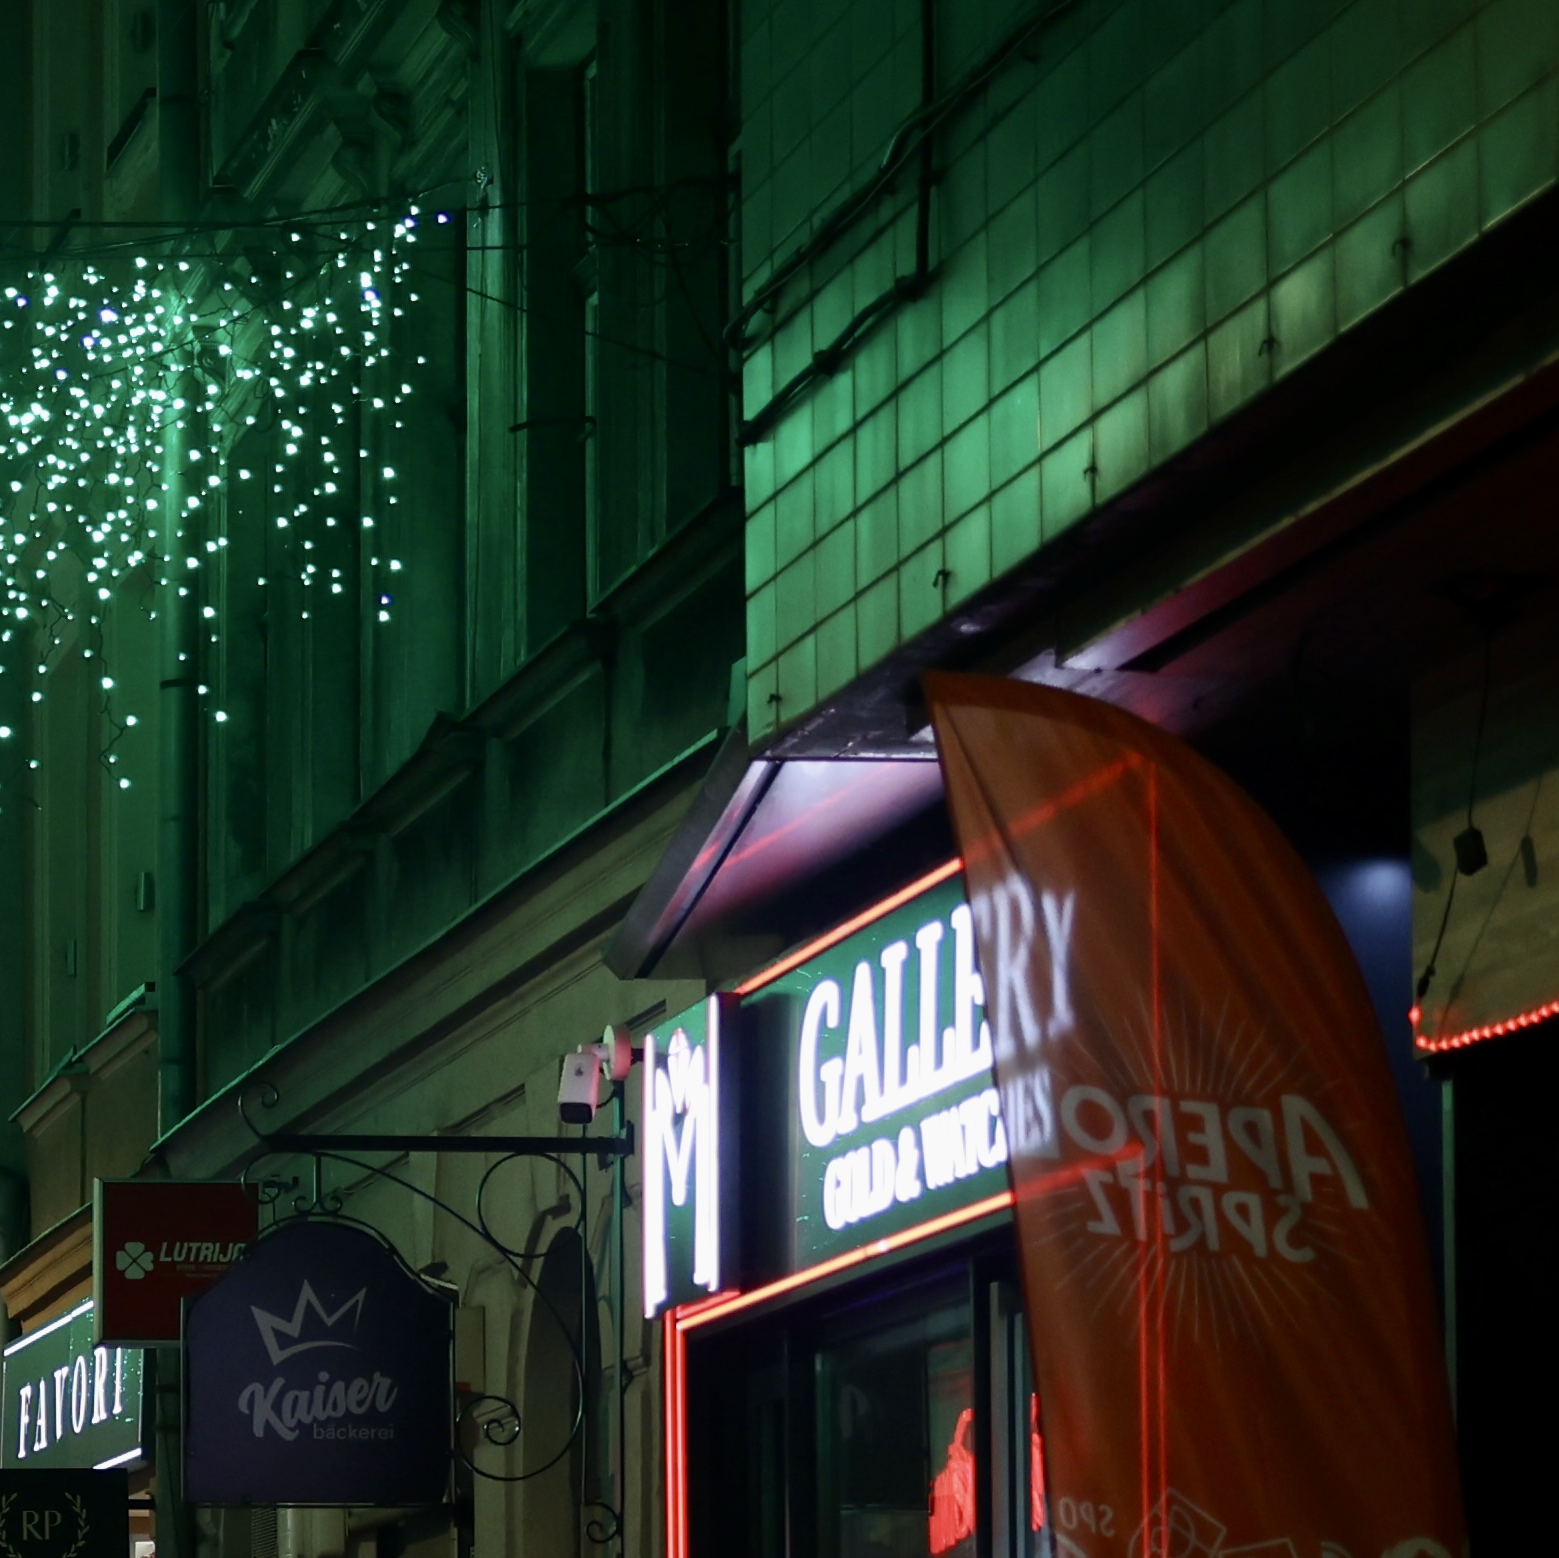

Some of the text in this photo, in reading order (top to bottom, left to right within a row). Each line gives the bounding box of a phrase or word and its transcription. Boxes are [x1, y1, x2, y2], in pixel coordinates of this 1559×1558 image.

[798, 868, 1076, 1148] GALLERY
[238, 1371, 399, 1441] Kaiser
[21, 1509, 62, 1541] RP
